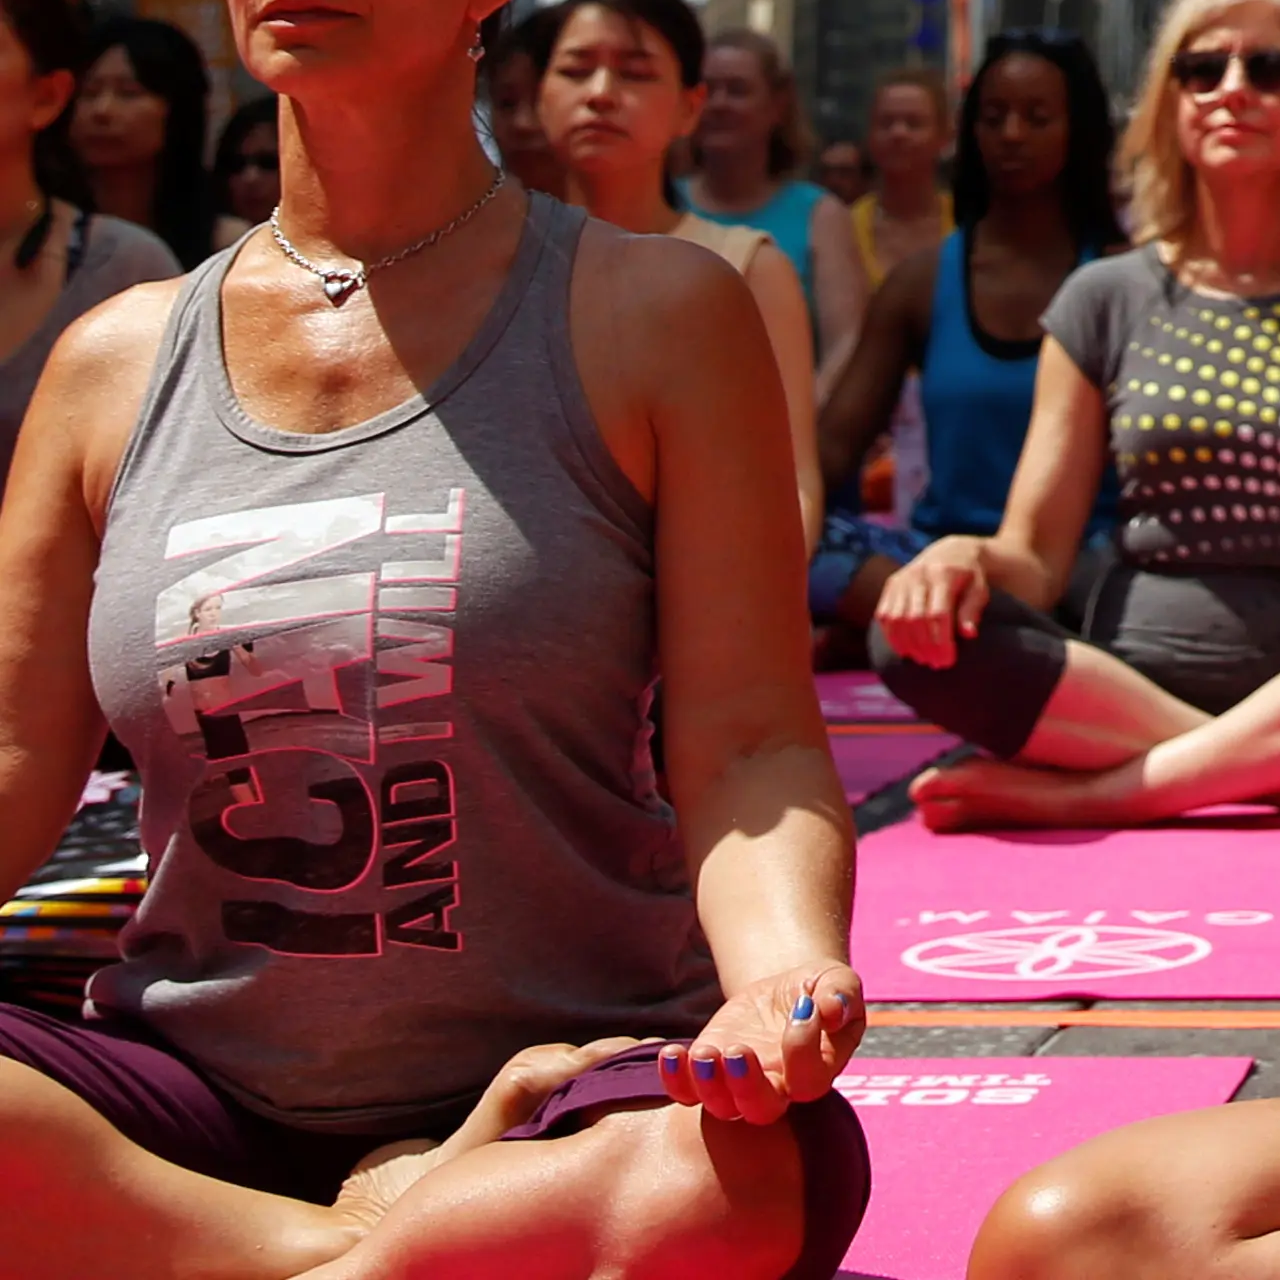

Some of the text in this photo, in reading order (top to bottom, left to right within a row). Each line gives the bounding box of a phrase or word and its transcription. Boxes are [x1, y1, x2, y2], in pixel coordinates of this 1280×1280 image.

[154, 491, 387, 959] I CAN
[376, 487, 467, 954] AND I WILL
[917, 909, 1275, 928] GAIAM
[846, 1087, 1041, 1107] SOL
